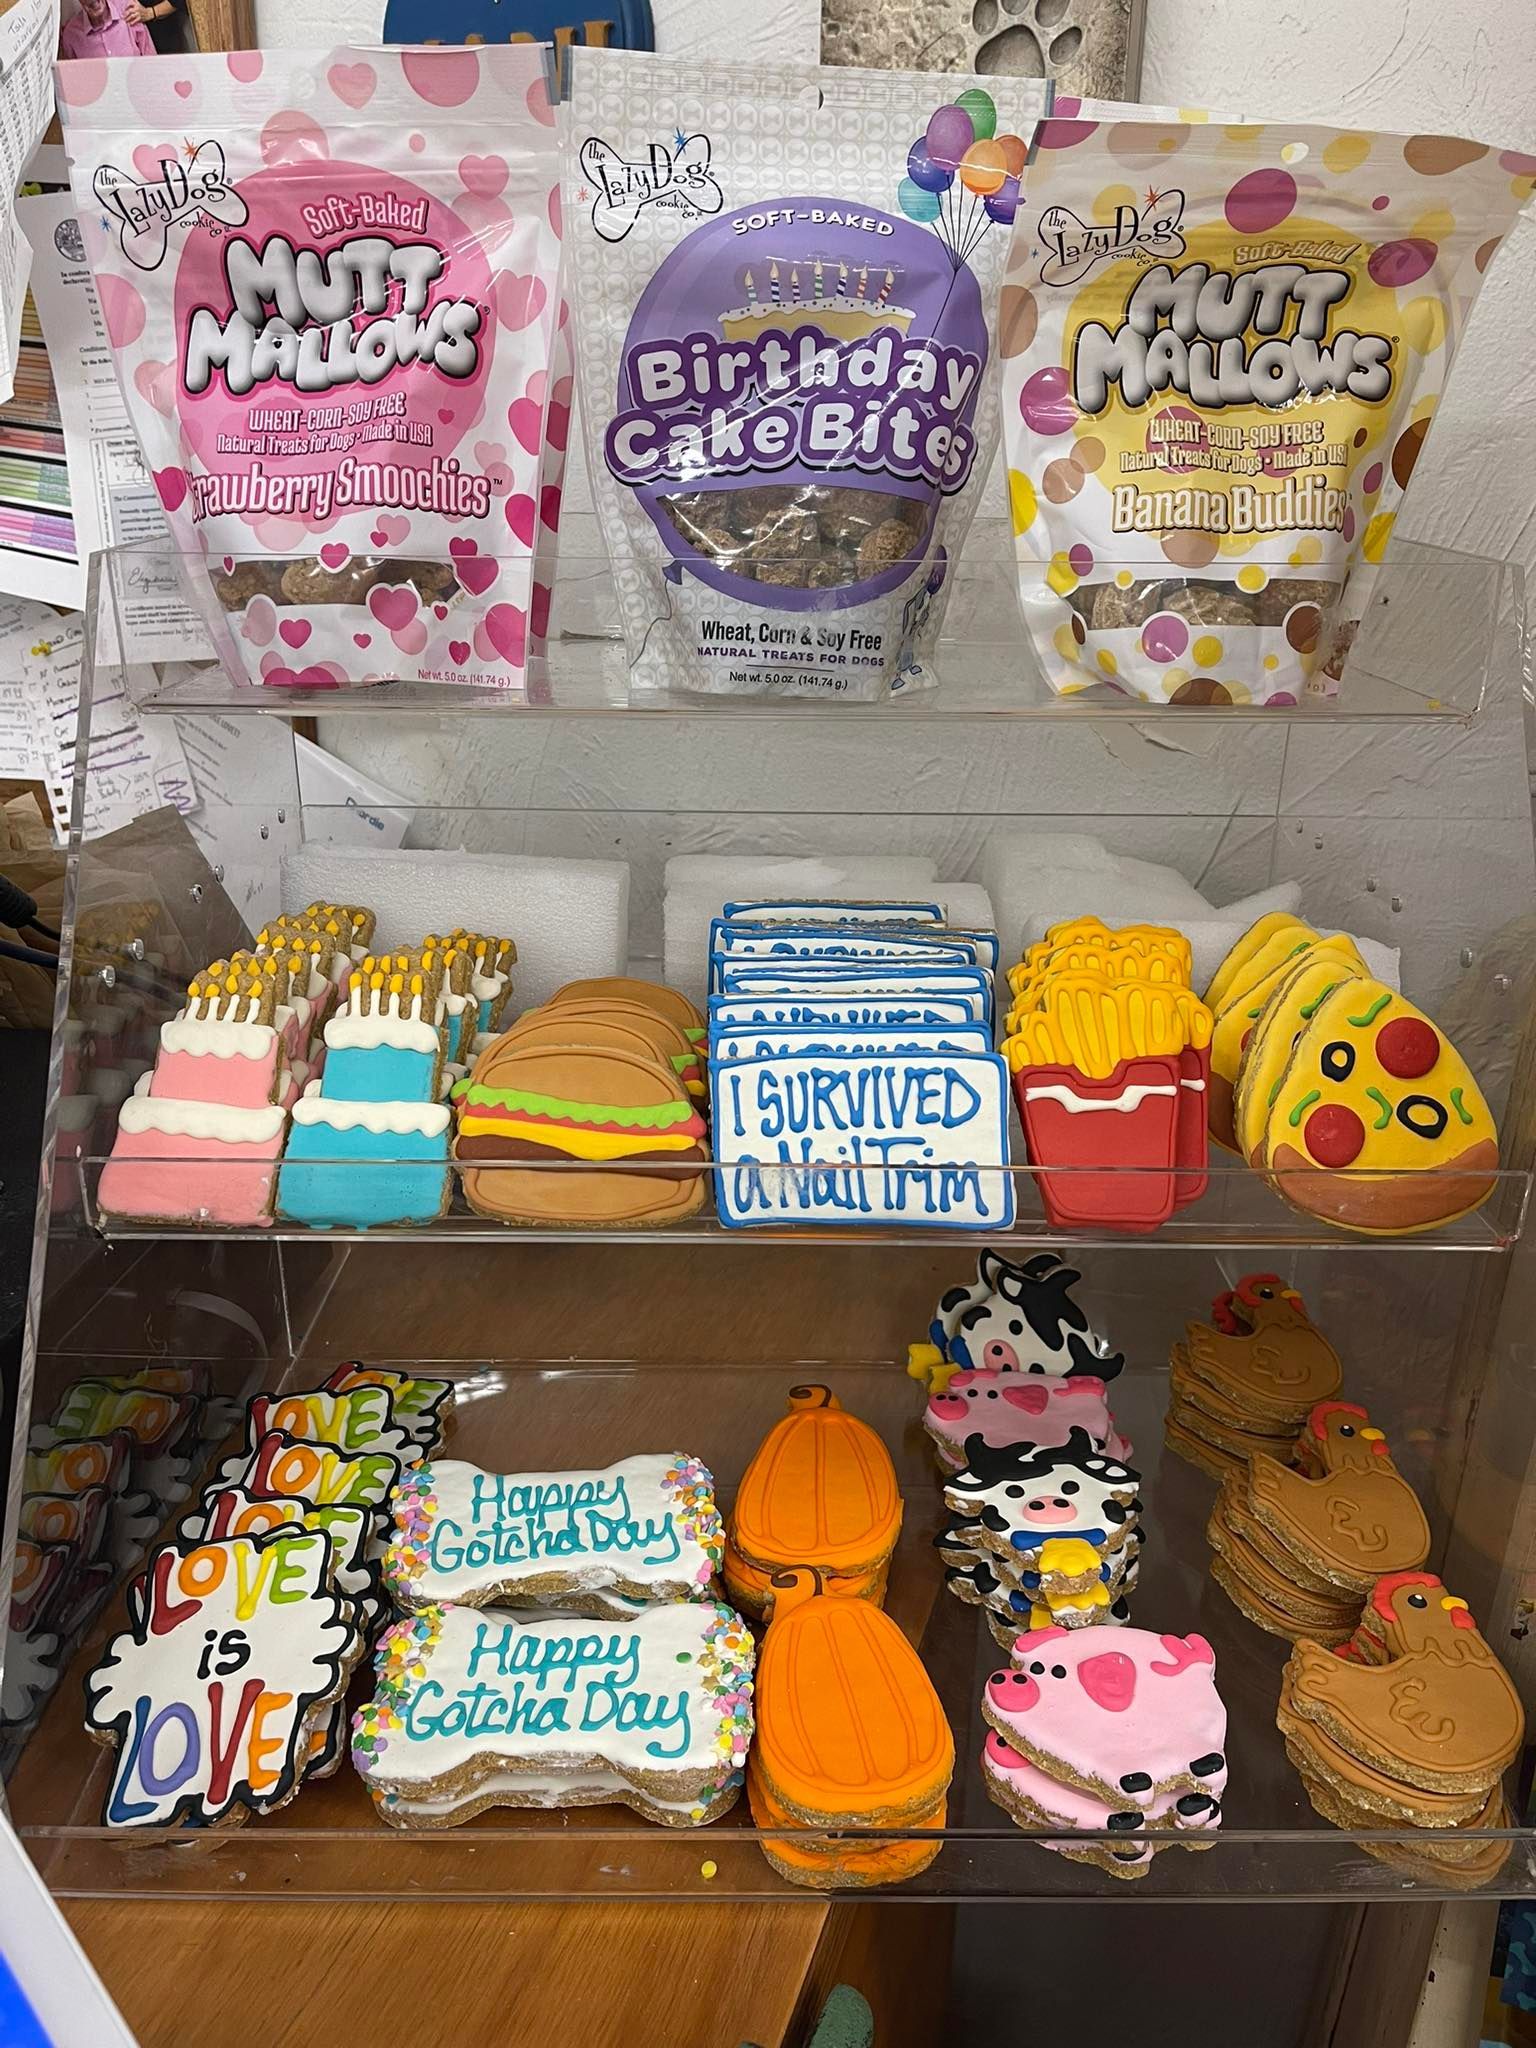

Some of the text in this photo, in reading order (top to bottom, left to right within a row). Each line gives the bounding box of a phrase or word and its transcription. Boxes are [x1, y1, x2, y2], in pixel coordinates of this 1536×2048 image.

[588, 142, 605, 161] the
[647, 144, 706, 189] Dog
[99, 168, 117, 187] the
[159, 159, 226, 210] Dog
[179, 211, 215, 228] cookie
[303, 195, 429, 237] Soft-Baked
[656, 194, 690, 209] cookie
[731, 208, 896, 236] SOFT-BAKED
[1048, 210, 1067, 229] the
[1114, 205, 1173, 248] Dog
[1112, 248, 1147, 260] cookie
[1234, 240, 1359, 266] Soft-Baked
[226, 235, 443, 328] MUTT
[1127, 263, 1351, 341] MUTT
[185, 300, 481, 395] MALLOWS
[1074, 322, 1392, 414] MALLOWS
[633, 333, 978, 413] Birthday
[249, 392, 407, 432] WHEAT-CORN-SOY FREE
[1150, 418, 1324, 449] WHEAT-CORN-SOY FREE
[217, 421, 433, 456] Natural Treats for Dogs Made in USA
[611, 399, 972, 480] Cake Bites
[1120, 444, 1169, 473] Natural
[1171, 446, 1211, 469] Treats
[1212, 452, 1232, 472] for
[1231, 455, 1263, 476] Dogs
[1273, 450, 1311, 471] Made
[1312, 445, 1328, 467] in
[336, 456, 491, 519] Smoochies
[1112, 474, 1346, 533] Banana Buddies
[697, 647, 885, 667] NATURAL TREATS FOR DOGS
[702, 620, 882, 651] Wheat, Corn & Soy Free
[418, 669, 431, 680] Net
[445, 670, 456, 682] 5.0
[470, 673, 496, 685] (141.74
[498, 676, 511, 687] g.)
[729, 671, 848, 690] Net wt. 5.0 oz. (141.74 g.)
[731, 1065, 982, 1138] I SURVIVED
[735, 1136, 990, 1216] a Nail Trim
[471, 1474, 632, 1531] Happy
[430, 1509, 681, 1574] Gotcha Day
[150, 1537, 310, 1636] LOVE
[197, 1629, 252, 1680] is
[466, 1622, 642, 1693] Happy
[405, 1680, 692, 1759] Gotcha Day
[109, 1678, 294, 1824] LOVE
